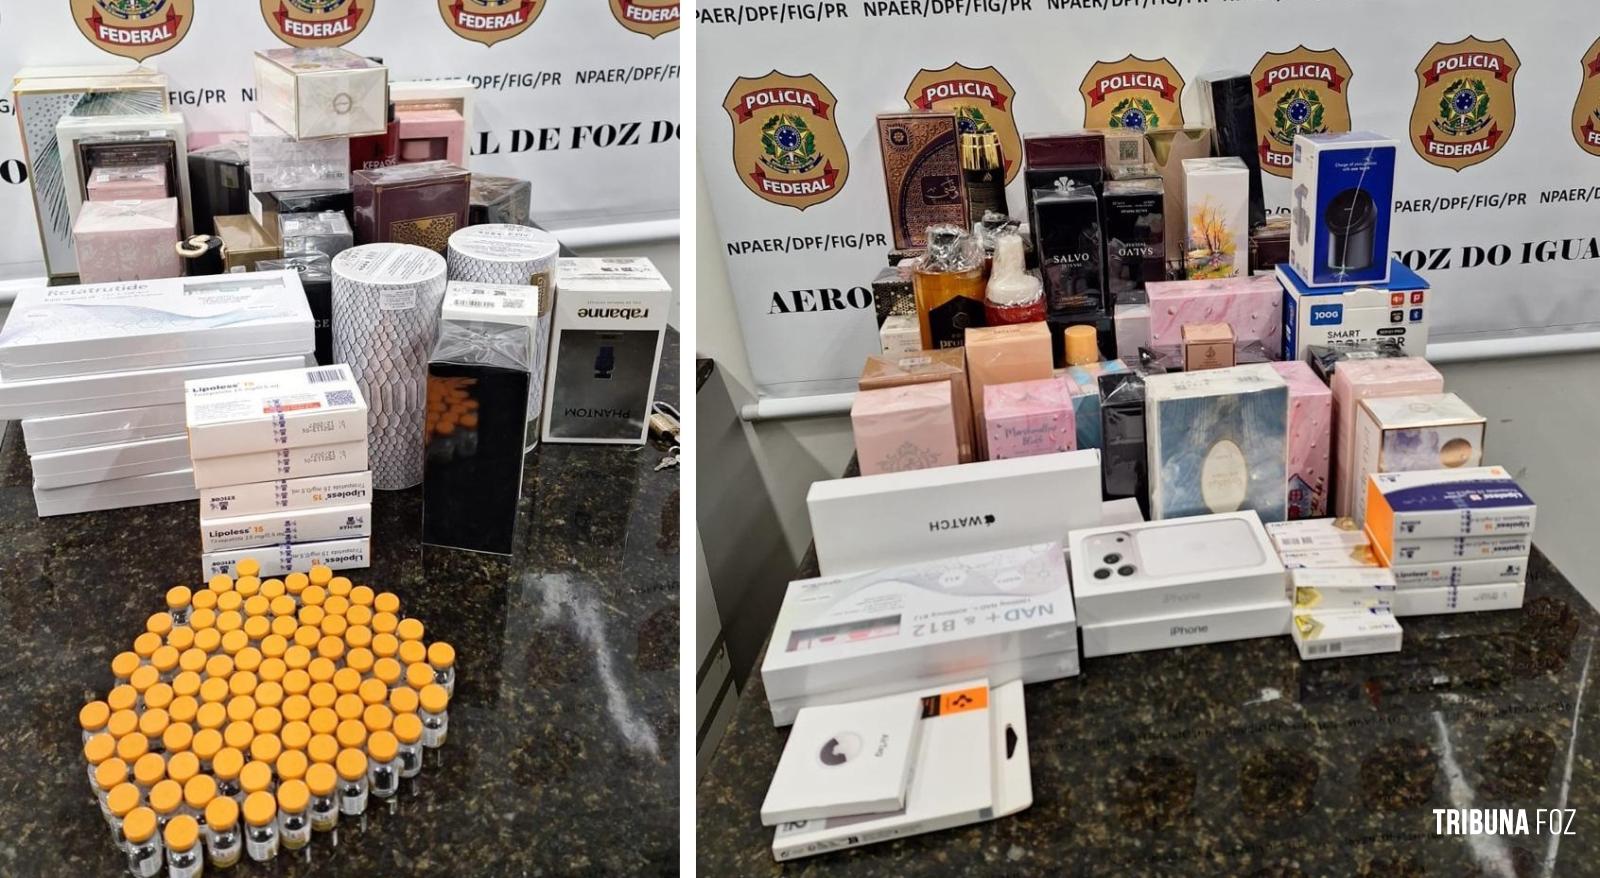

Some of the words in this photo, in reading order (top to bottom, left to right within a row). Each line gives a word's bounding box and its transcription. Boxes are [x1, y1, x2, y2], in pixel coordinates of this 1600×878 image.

[284, 19, 353, 37] FEDERAL
[458, 12, 524, 29] FEDERAL
[99, 23, 172, 44] FEDERAL
[510, 127, 561, 153] DE
[571, 121, 642, 150] FOZ
[1429, 139, 1490, 156] FEDERAL
[762, 178, 830, 195] FEDERAL
[727, 232, 888, 257] NPAER/DPF/FIG/PR
[1118, 246, 1154, 257] SALVO
[1053, 252, 1090, 264] SALVO
[1458, 242, 1511, 269] DO
[47, 282, 149, 297] Retatrutide
[767, 285, 874, 316] AERO
[577, 307, 650, 320] rabanne
[1314, 312, 1339, 321] JOOG
[1327, 329, 1361, 339] SMART
[563, 407, 631, 420] PHANTOM
[312, 494, 323, 502] 15
[325, 489, 366, 500] Lipoless
[929, 516, 983, 532] WATCH
[209, 527, 250, 539] Lipoless
[325, 553, 363, 564] Lipoless
[1161, 590, 1202, 603] iPhone
[985, 602, 1054, 624] NAD+
[912, 619, 956, 637] B12
[1169, 623, 1209, 637] iPhone
